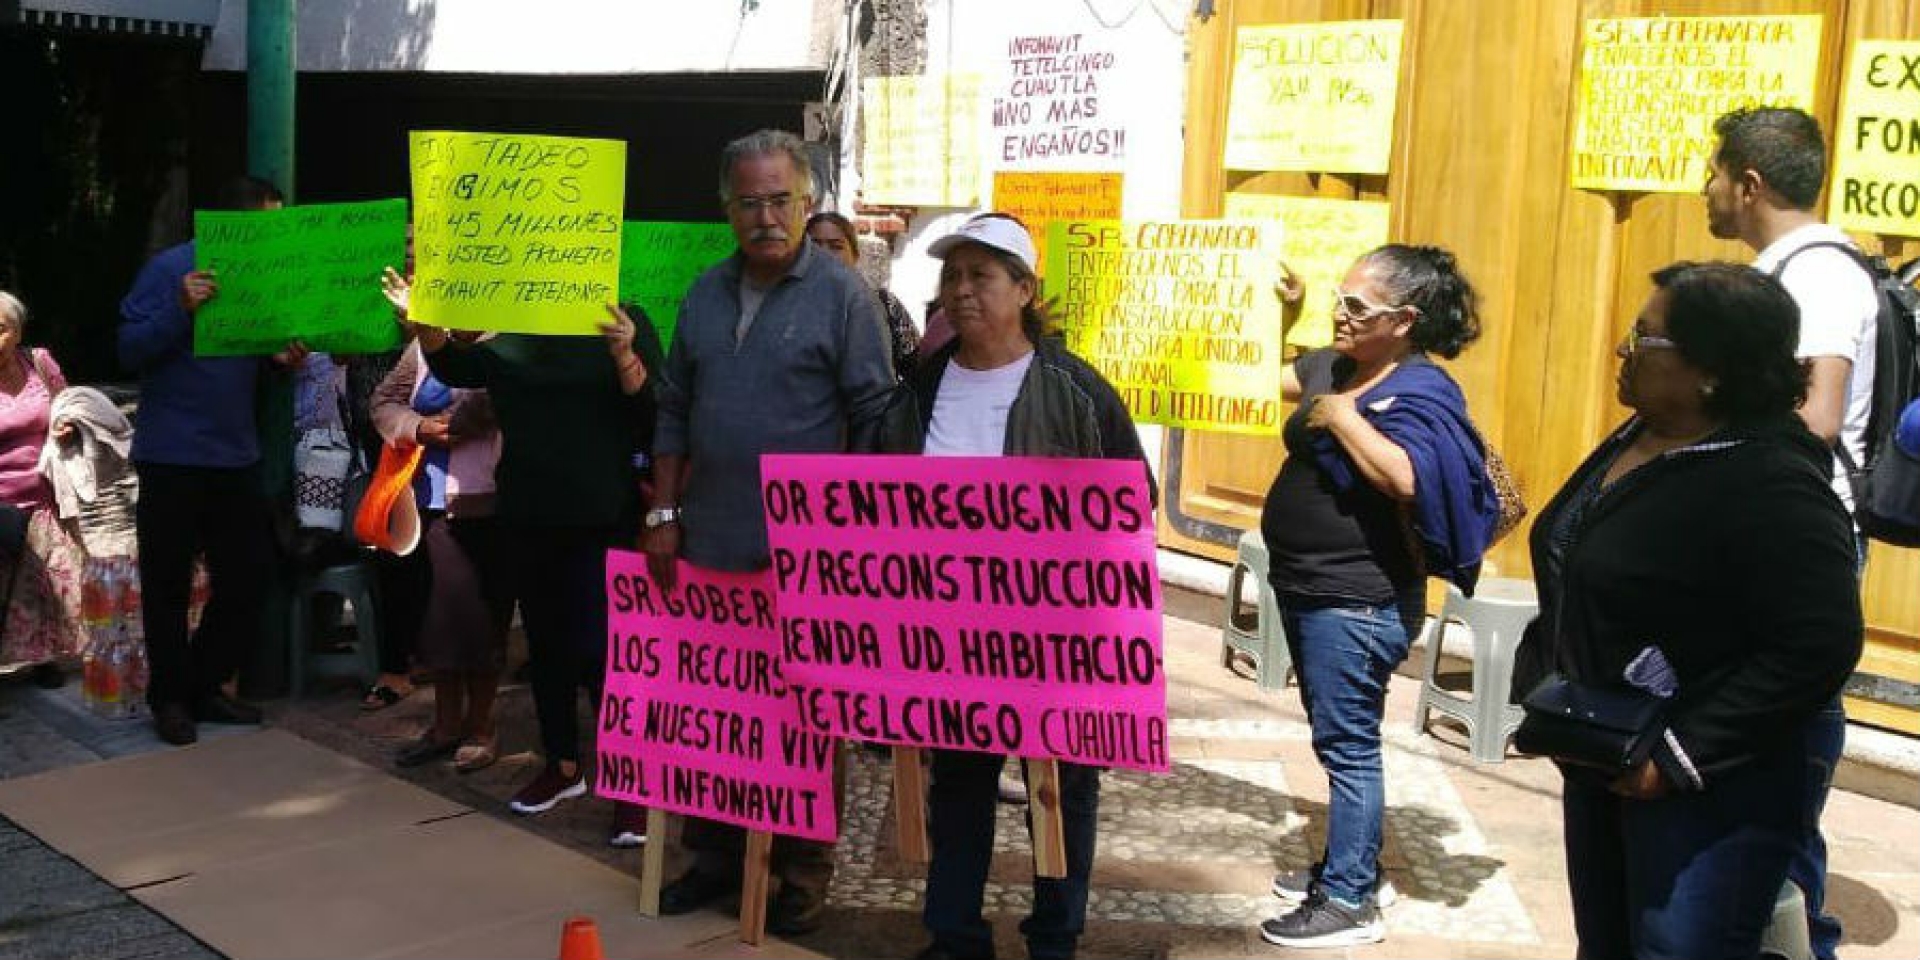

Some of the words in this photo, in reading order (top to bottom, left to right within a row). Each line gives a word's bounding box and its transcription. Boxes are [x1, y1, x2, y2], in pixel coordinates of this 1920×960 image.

[1008, 33, 1083, 58] INFONAVIT
[1010, 51, 1115, 77] TETELCINGO
[1010, 74, 1098, 98] CUAUTLA
[1046, 97, 1098, 123] MAS
[471, 138, 591, 171] TADEO
[447, 211, 482, 238] 45
[494, 210, 618, 237] MILLONES
[1136, 222, 1262, 250] GOBERNADOR
[446, 243, 513, 266] USTED
[1217, 253, 1244, 278] EL
[1173, 279, 1219, 307] PARA
[1229, 283, 1254, 310] LA
[1098, 330, 1184, 359] NUESTRA
[1194, 337, 1263, 366] UNIDAD
[766, 480, 813, 525] OR
[612, 633, 662, 679] LOS
[901, 624, 951, 675] UD.
[603, 692, 635, 737] DE
[644, 702, 765, 762] NUESTRA
[780, 721, 831, 773] VIV
[789, 684, 1023, 750] TETELCINGO
[1040, 708, 1166, 766] CUAUTLA
[600, 751, 650, 797] NAL
[662, 763, 818, 830] INFONAVIT
